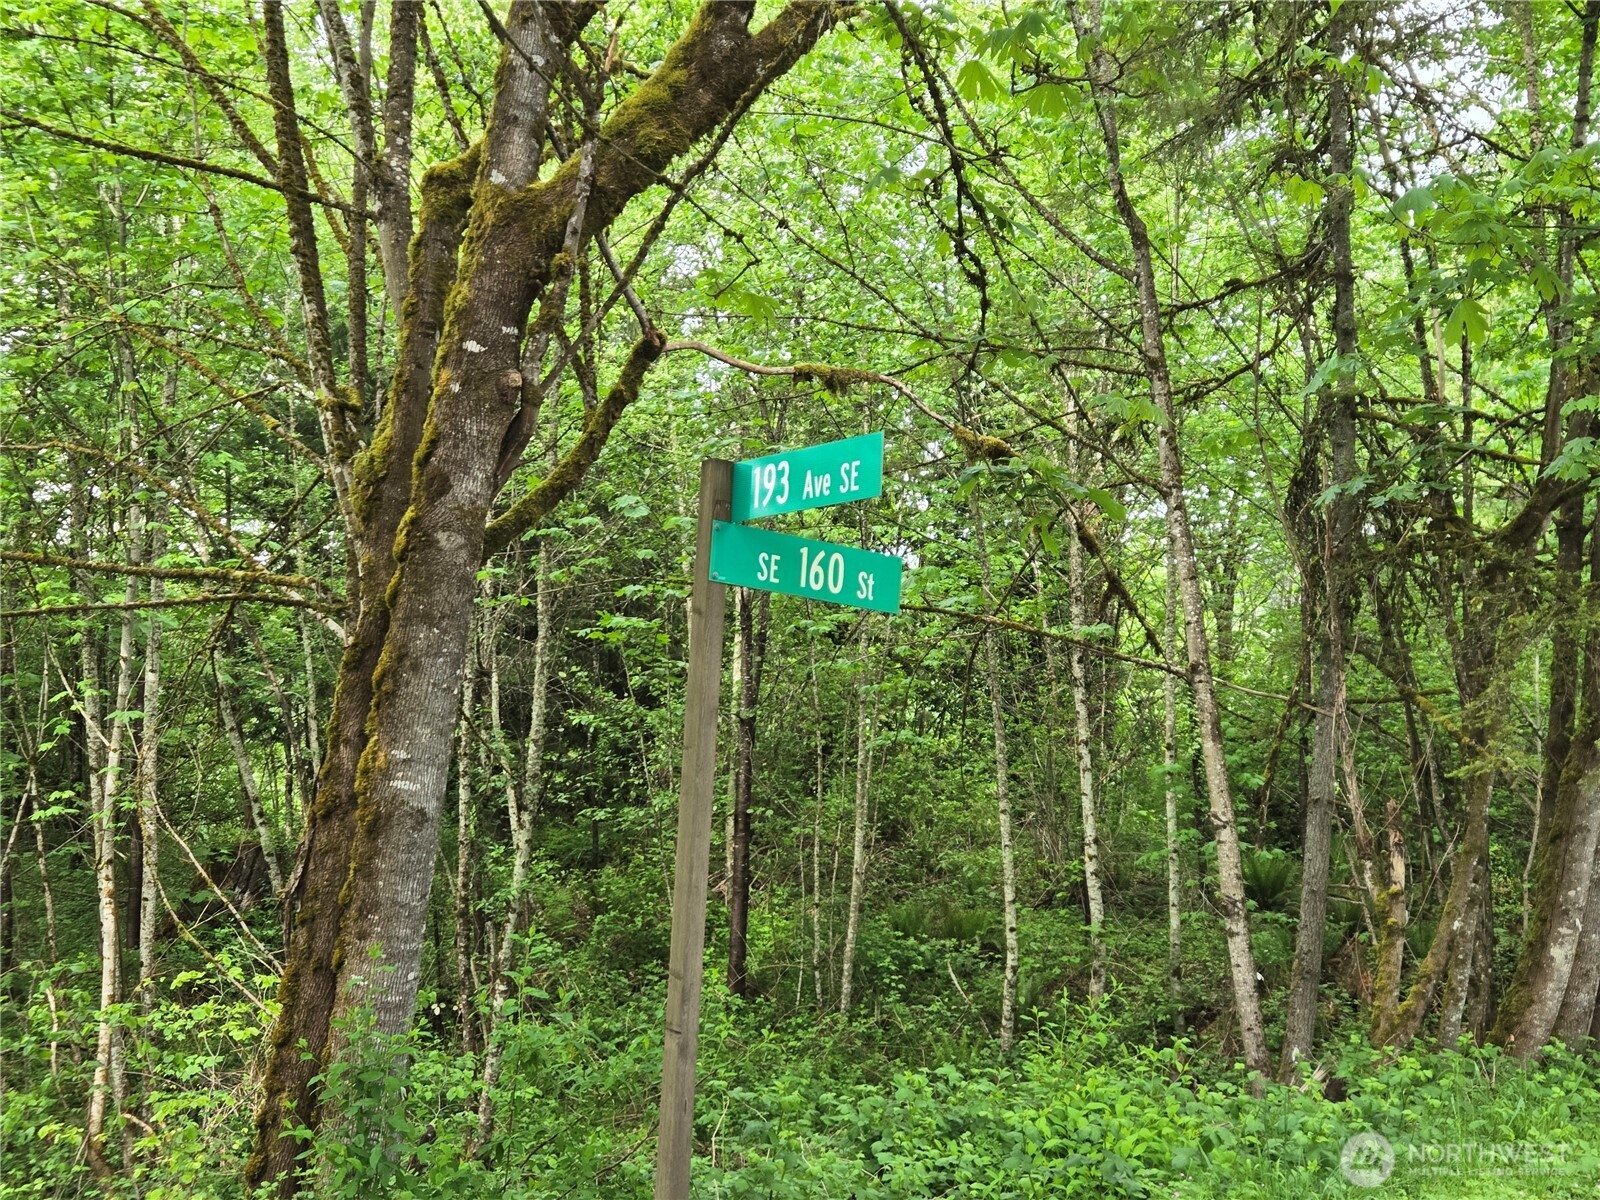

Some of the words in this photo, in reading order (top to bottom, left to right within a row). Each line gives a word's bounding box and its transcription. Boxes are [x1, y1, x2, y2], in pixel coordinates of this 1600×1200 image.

[753, 460, 790, 508] 193
[802, 470, 831, 500] Ave
[839, 460, 861, 494] SE
[757, 552, 781, 584] SE
[800, 546, 845, 594] 160
[856, 571, 875, 601] St
